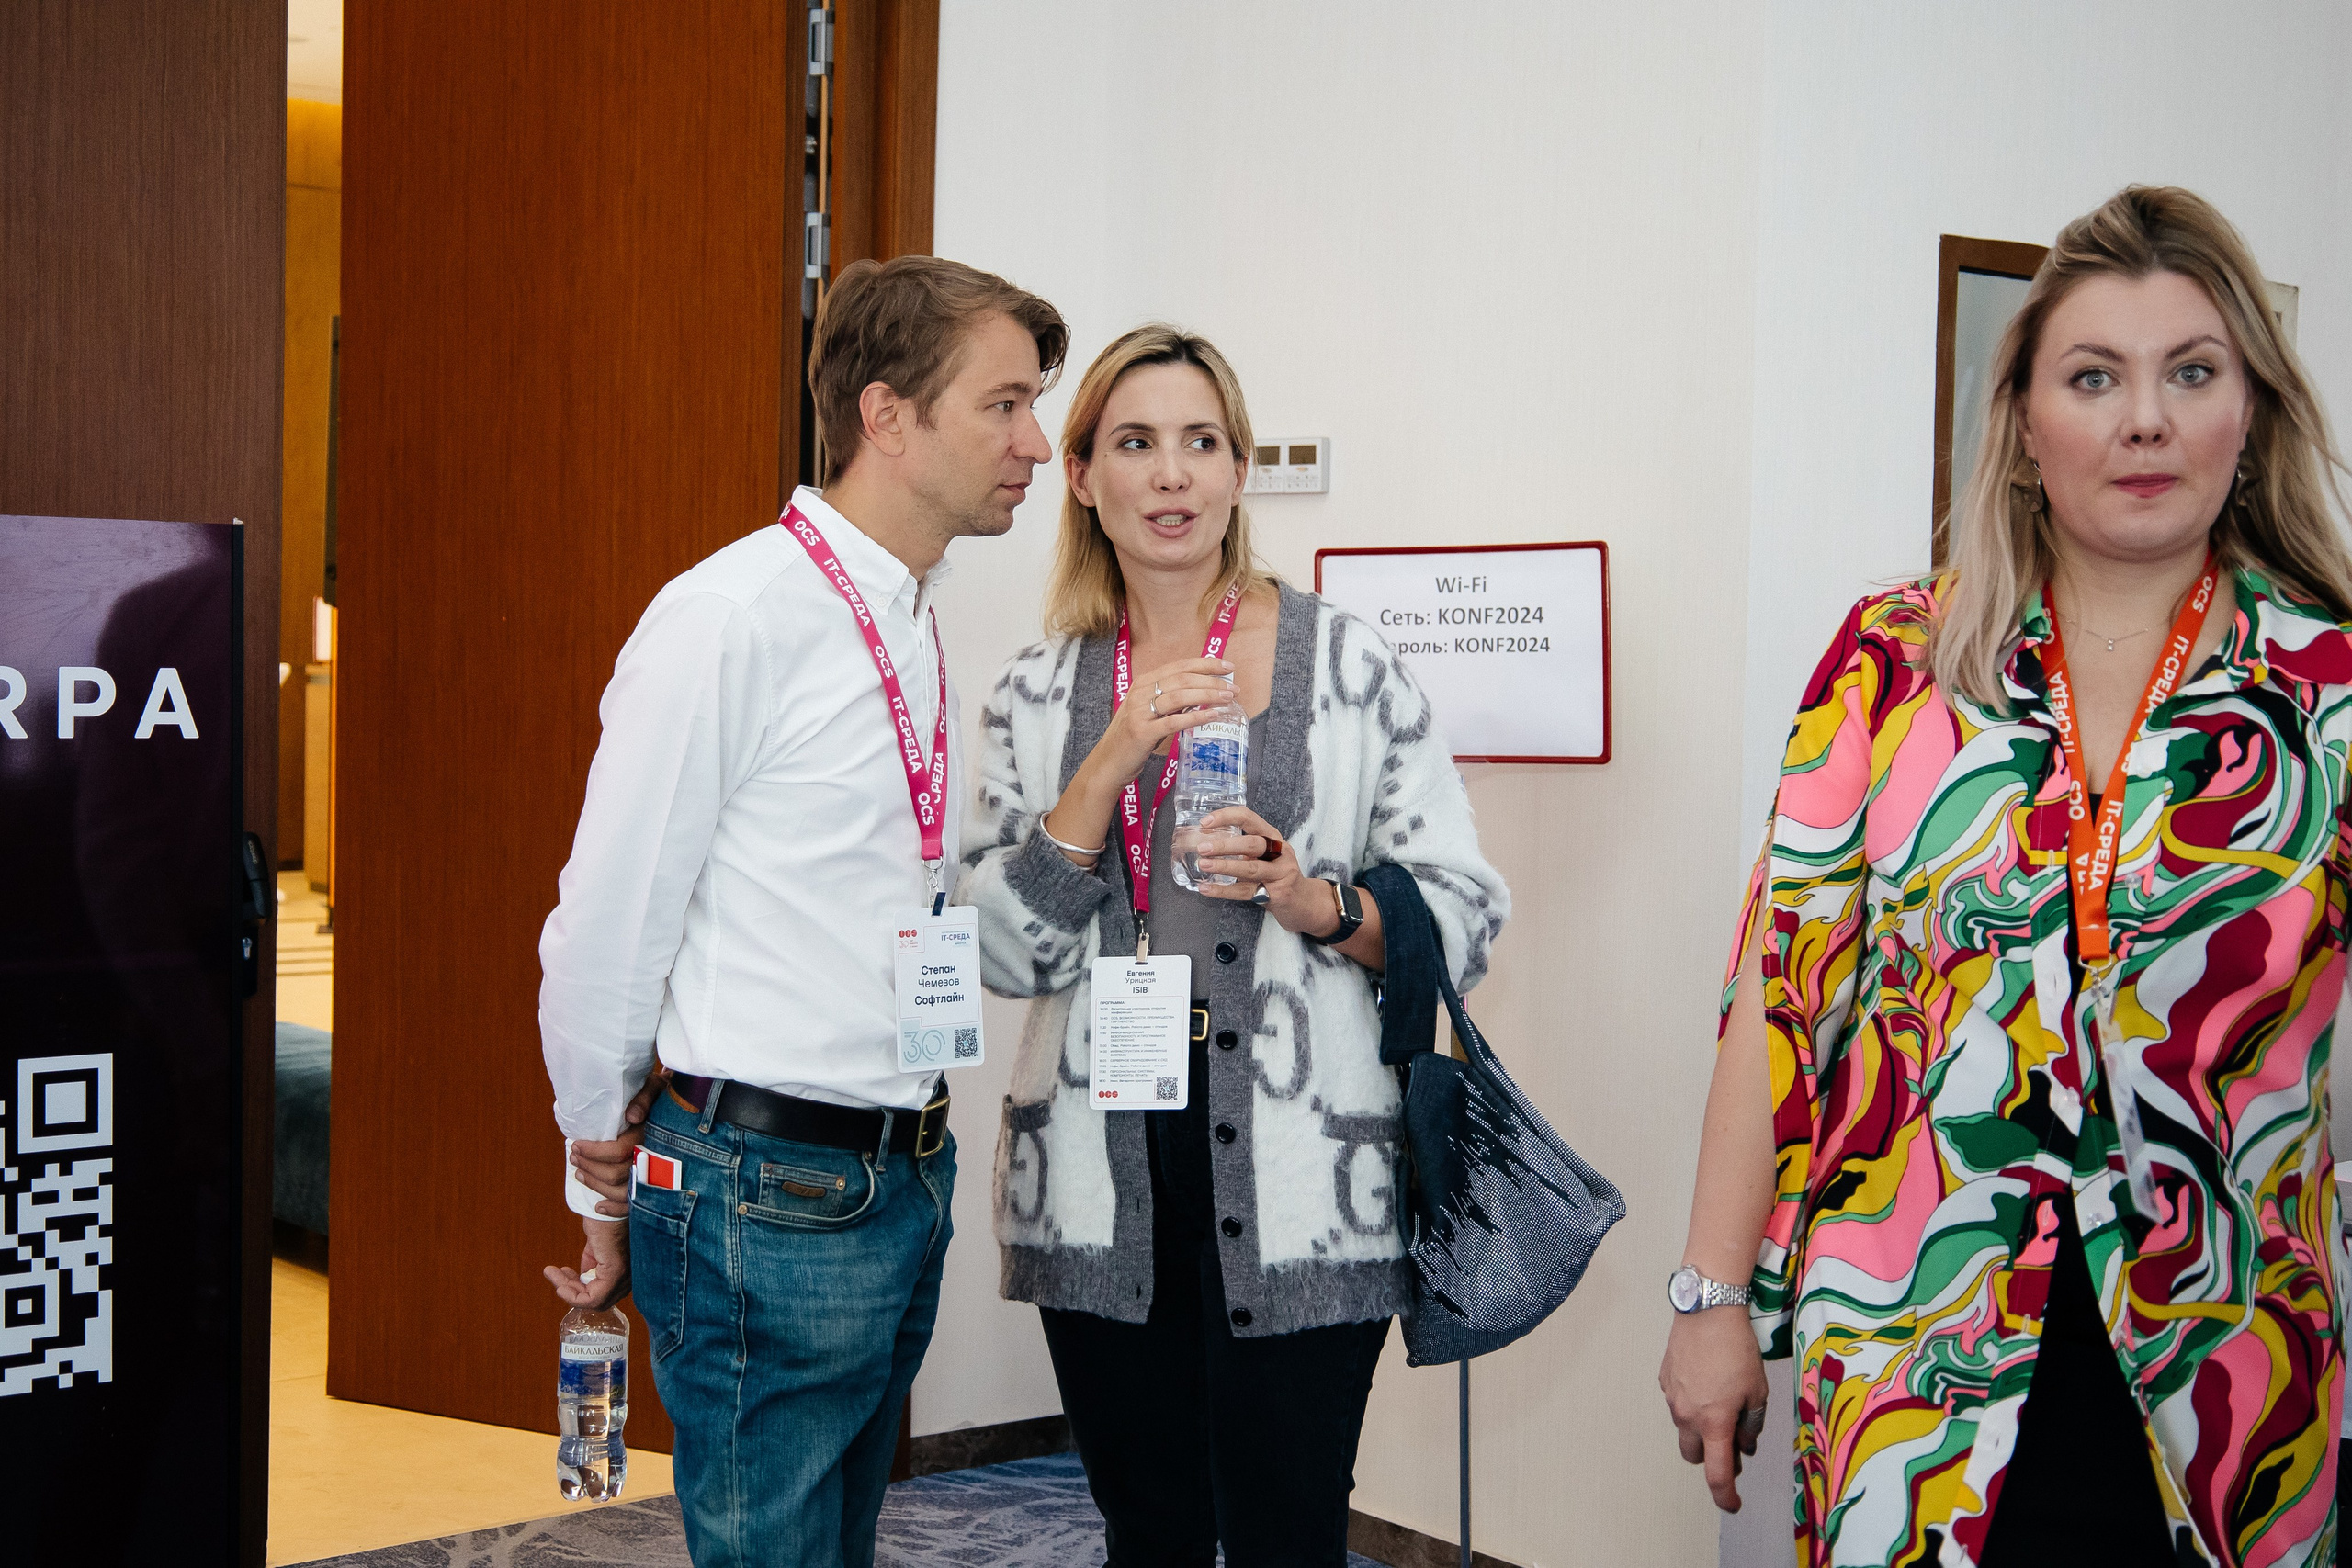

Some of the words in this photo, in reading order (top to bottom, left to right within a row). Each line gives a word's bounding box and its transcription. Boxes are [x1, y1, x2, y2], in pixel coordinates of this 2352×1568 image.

[794, 520, 820, 547] OCS
[824, 558, 871, 627] IT-СРЕДА
[1435, 576, 1487, 594] Wi-Fi
[2192, 575, 2213, 613] OCS
[1380, 608, 1431, 626] Сеть:
[1438, 606, 1544, 626] KONF2024
[875, 645, 894, 679] OCS
[1390, 642, 1448, 657] роль:
[1454, 637, 1551, 654] KONF2024
[1116, 640, 1129, 702] IT-СРЕДА
[2144, 634, 2189, 714] IT-СРЕДА
[939, 702, 947, 734] OCS
[892, 695, 922, 774] IT-СРЕДА
[1161, 758, 1178, 789] OCS
[918, 792, 935, 826] OCS
[1124, 781, 1138, 826] РЕДА
[2067, 780, 2086, 820] OCS
[2088, 799, 2124, 891] IT-СРЕДА
[899, 929, 918, 938] OCS
[941, 933, 971, 942] IT-СРЕДА
[918, 977, 960, 988] Чемезов
[921, 965, 956, 976] Степан
[914, 992, 965, 1006] Софтлайн
[564, 1343, 624, 1355] БАЙКАЛЬСКАЯ
